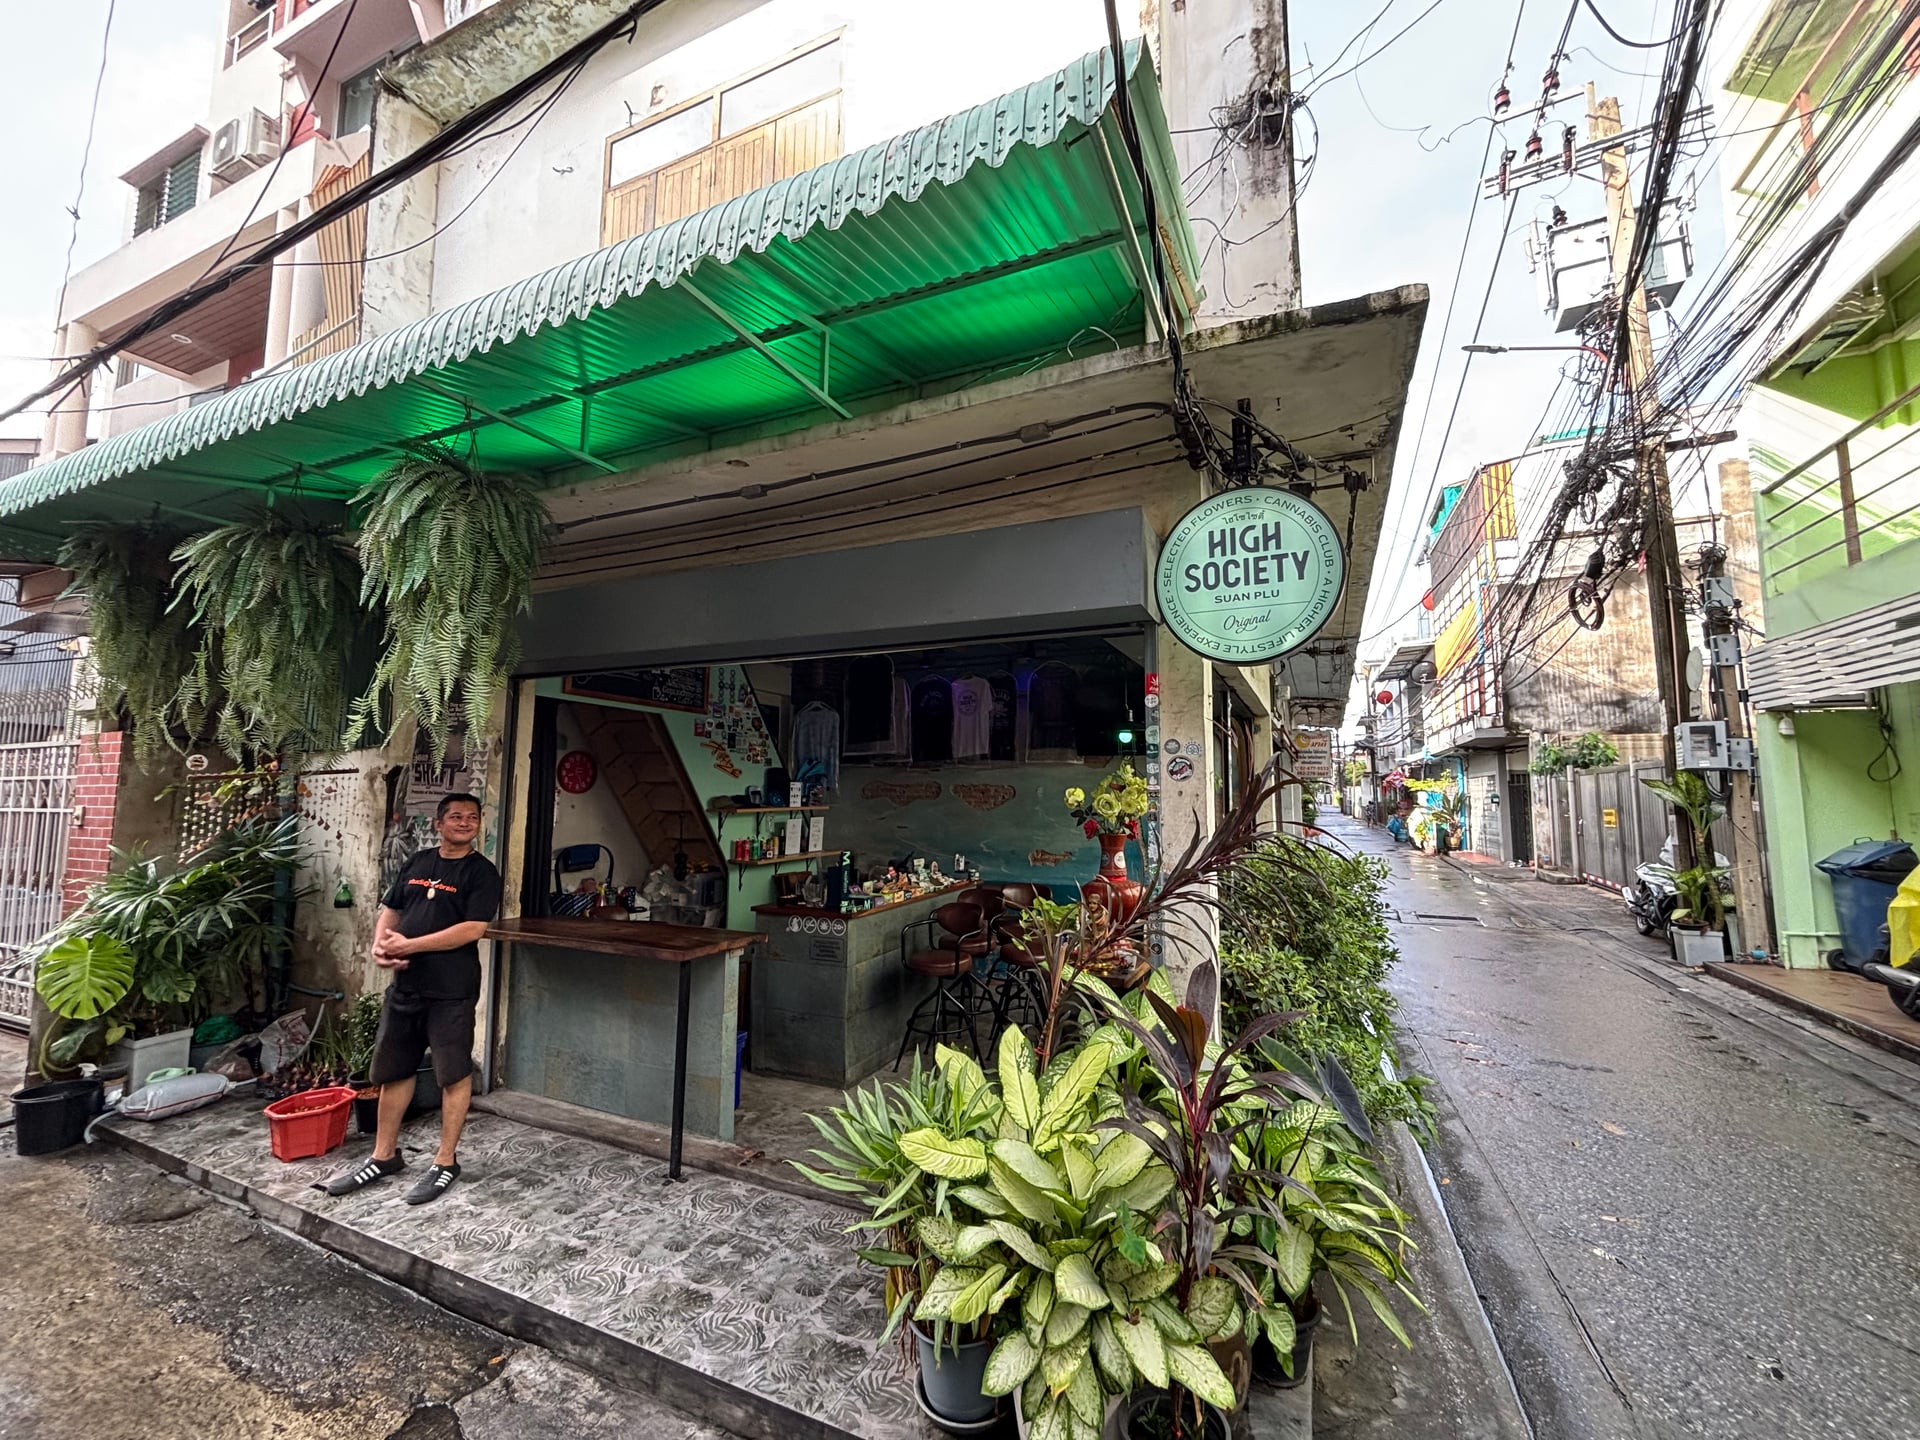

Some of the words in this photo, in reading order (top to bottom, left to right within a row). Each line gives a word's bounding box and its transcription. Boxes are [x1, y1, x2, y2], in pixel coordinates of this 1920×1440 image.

[1163, 526, 1191, 587] SELECTED
[1190, 495, 1253, 527] FLOWERS
[1208, 521, 1281, 558] HIGH
[1264, 496, 1323, 534] CANNABIS
[1318, 534, 1334, 568] CLUB
[1184, 550, 1310, 593] SOCIETY
[1322, 577, 1333, 586] A
[1214, 592, 1251, 604] SUAN
[1254, 588, 1280, 600] PLU
[1294, 589, 1331, 633] HIGHER
[1165, 595, 1221, 650] EXPERIENCE
[1223, 608, 1272, 635] Original
[1222, 630, 1295, 654] LIFESTYLE
